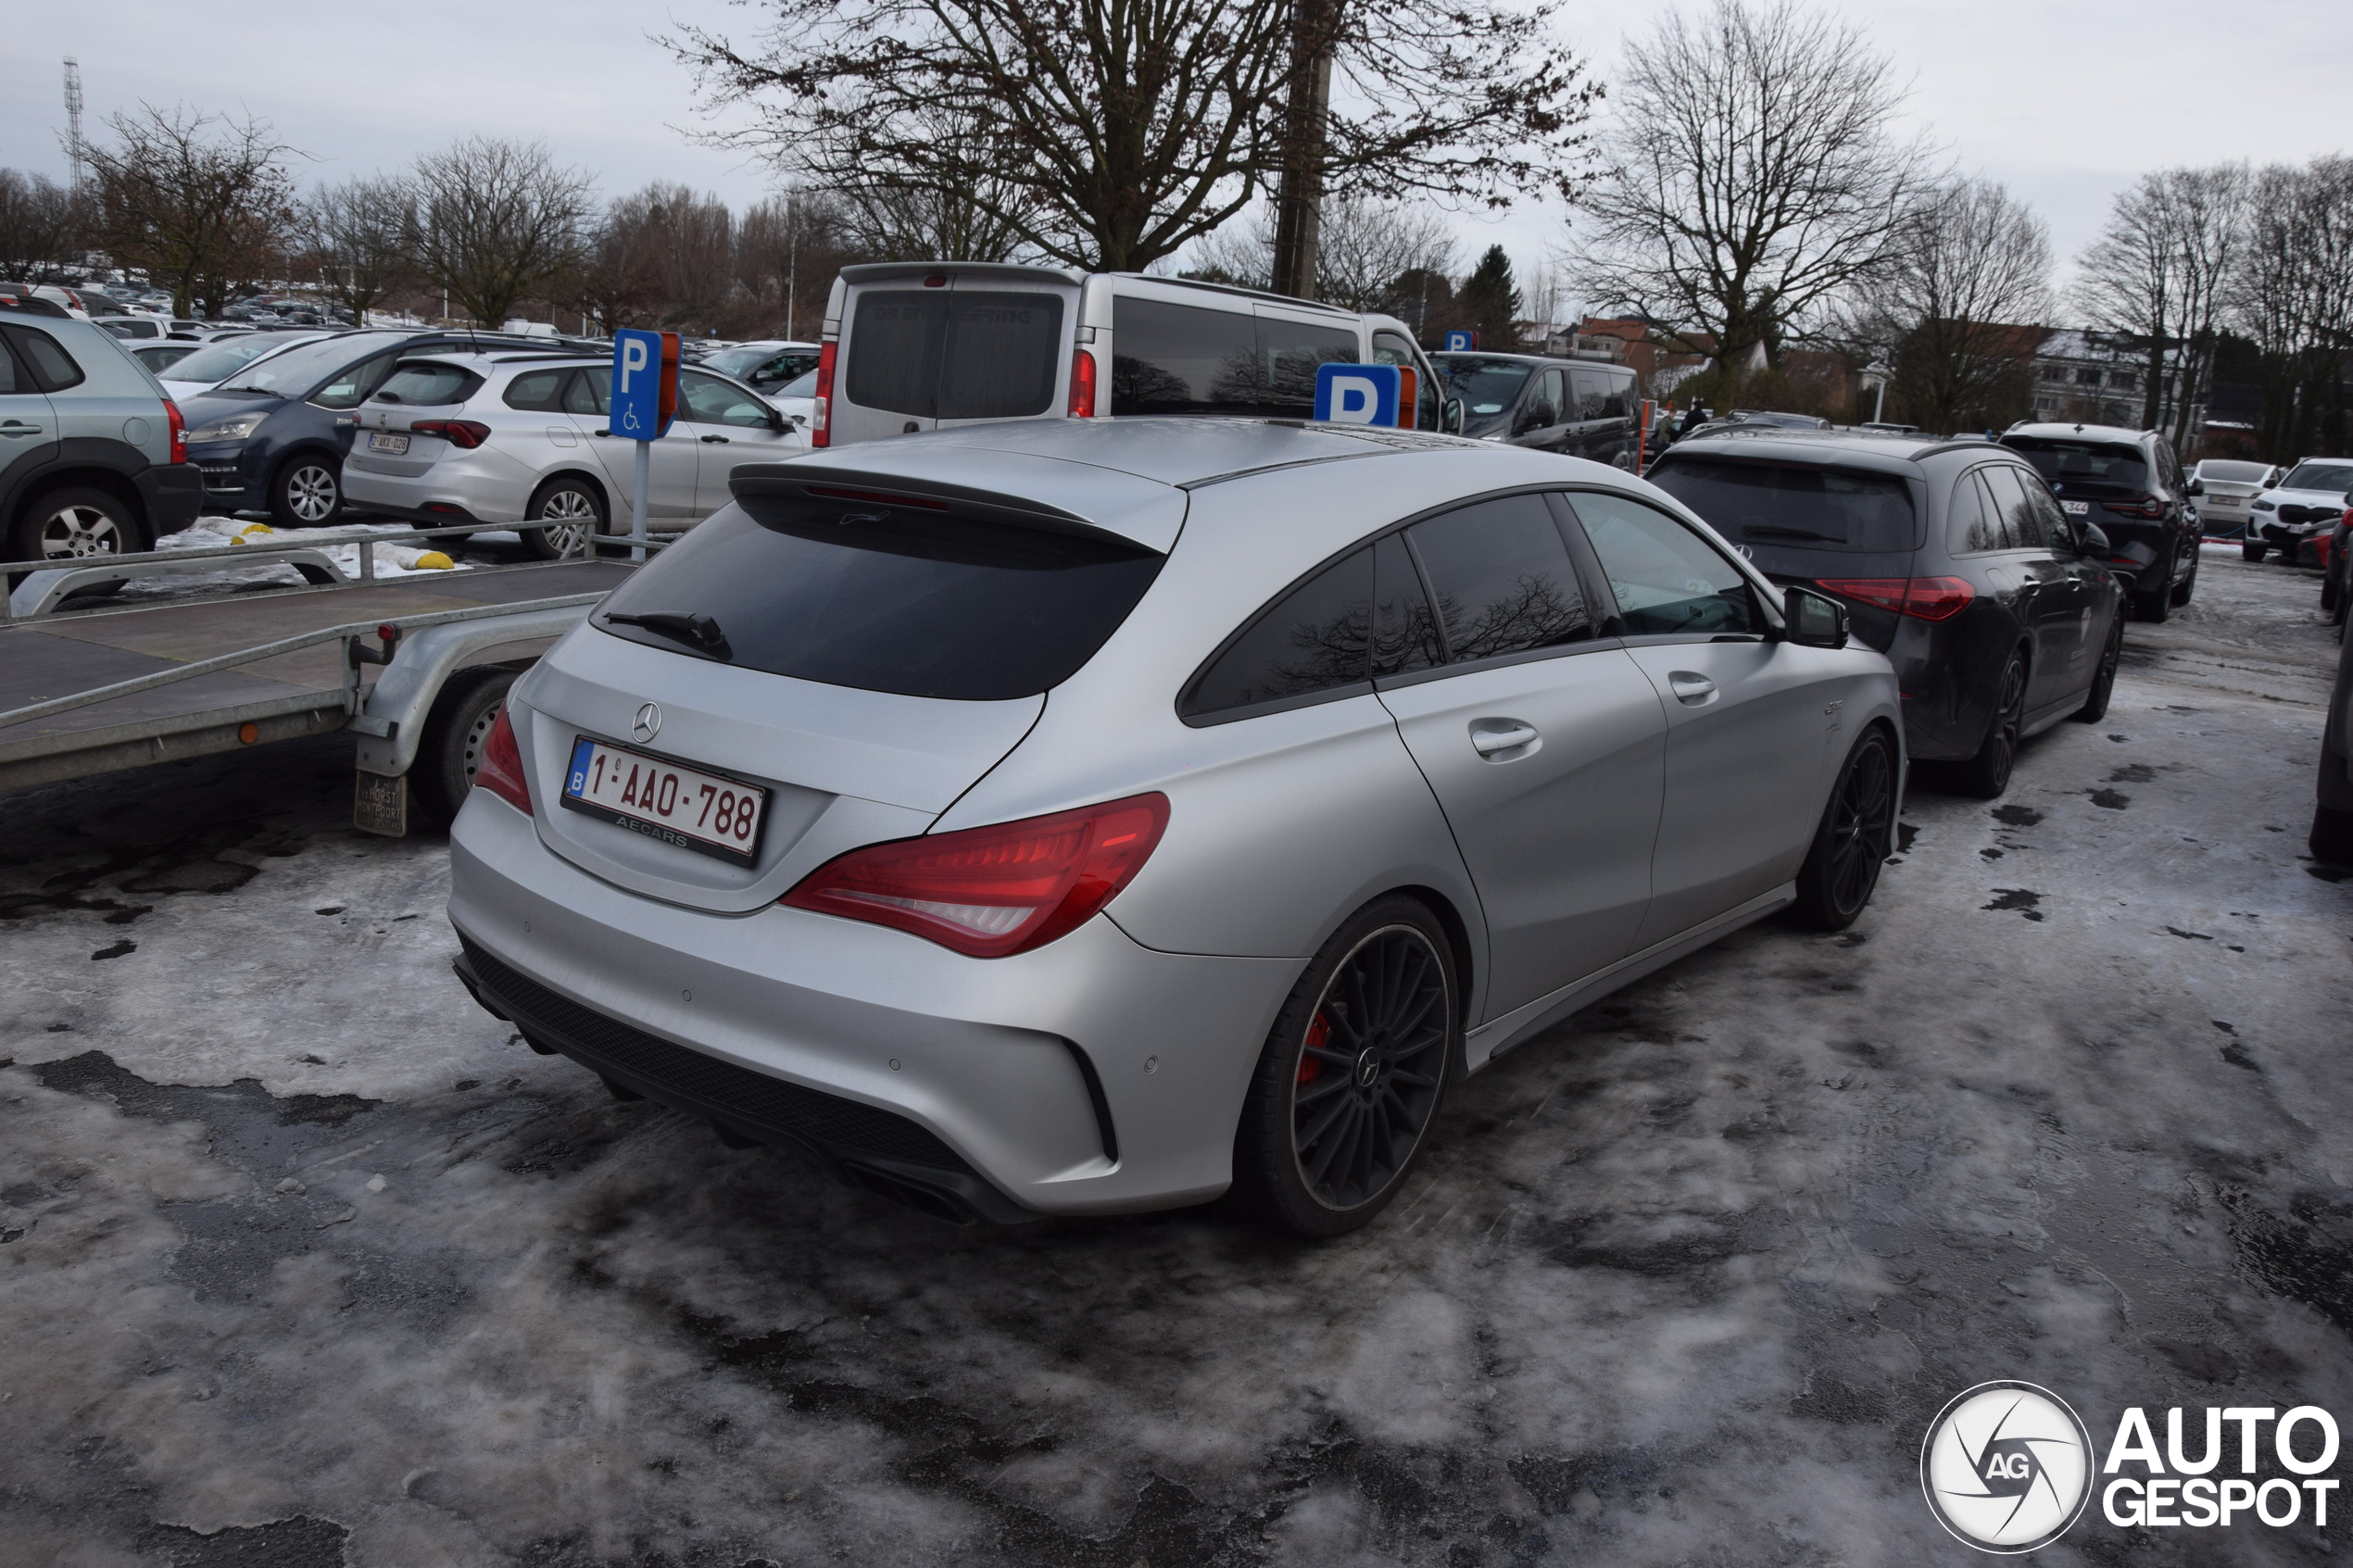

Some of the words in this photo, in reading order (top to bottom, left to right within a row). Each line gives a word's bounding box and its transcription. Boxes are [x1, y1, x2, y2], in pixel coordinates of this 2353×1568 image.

[1451, 334, 1466, 351] P
[621, 337, 648, 394] P
[370, 786, 396, 805] HORST
[571, 771, 584, 791] B
[593, 754, 755, 841] 1-AAO-788
[358, 800, 401, 820] MONTFOORT
[616, 816, 687, 847] AECARS
